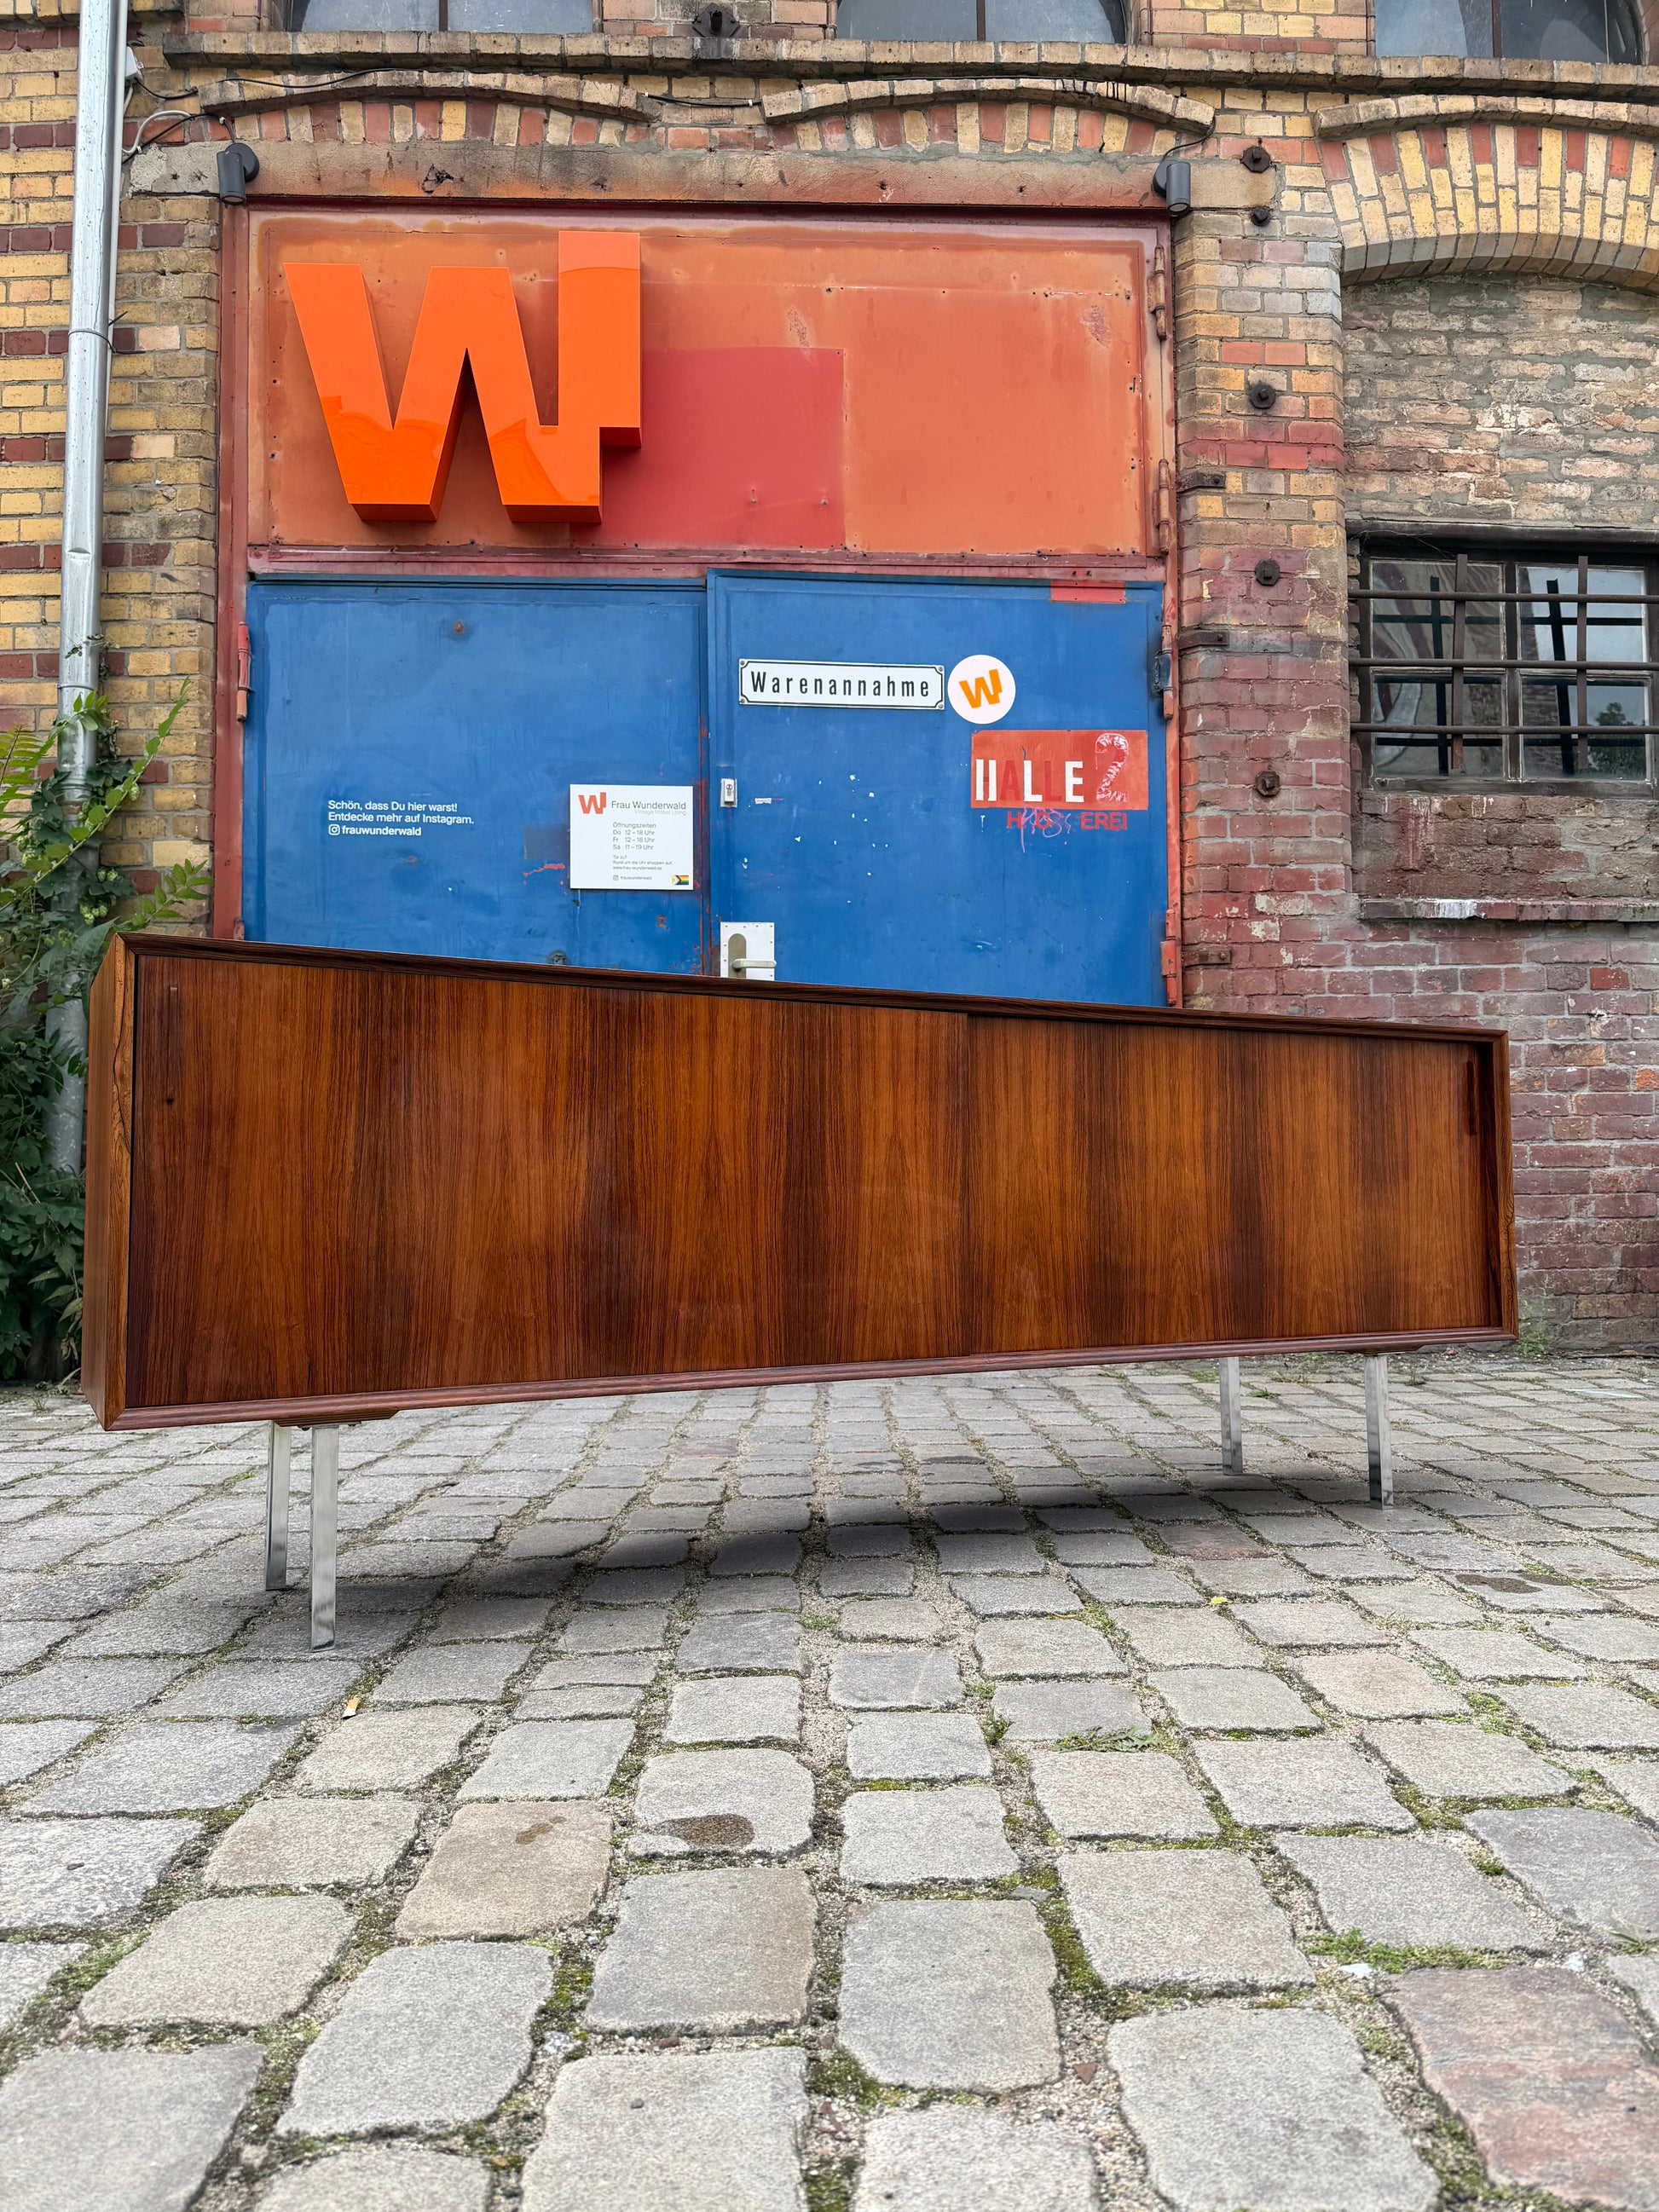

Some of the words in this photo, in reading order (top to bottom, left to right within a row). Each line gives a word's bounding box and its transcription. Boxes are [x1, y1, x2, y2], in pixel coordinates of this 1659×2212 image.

[283, 230, 642, 523] W
[750, 671, 929, 697] Warenannahme
[959, 669, 1003, 708] W
[975, 759, 1084, 803] HALLE
[328, 800, 363, 811] Schön,
[365, 801, 389, 810] dass
[391, 801, 405, 811] Du
[408, 802, 426, 811] hier
[428, 803, 457, 811] warst!
[578, 792, 606, 814] W
[611, 800, 631, 809] Frau
[633, 800, 686, 810] Wunderwald
[328, 811, 374, 822] Entdecke
[377, 813, 402, 822] mehr
[404, 813, 420, 823] auf
[423, 814, 474, 825] Instagram.
[342, 825, 422, 836] frauwunderwald
